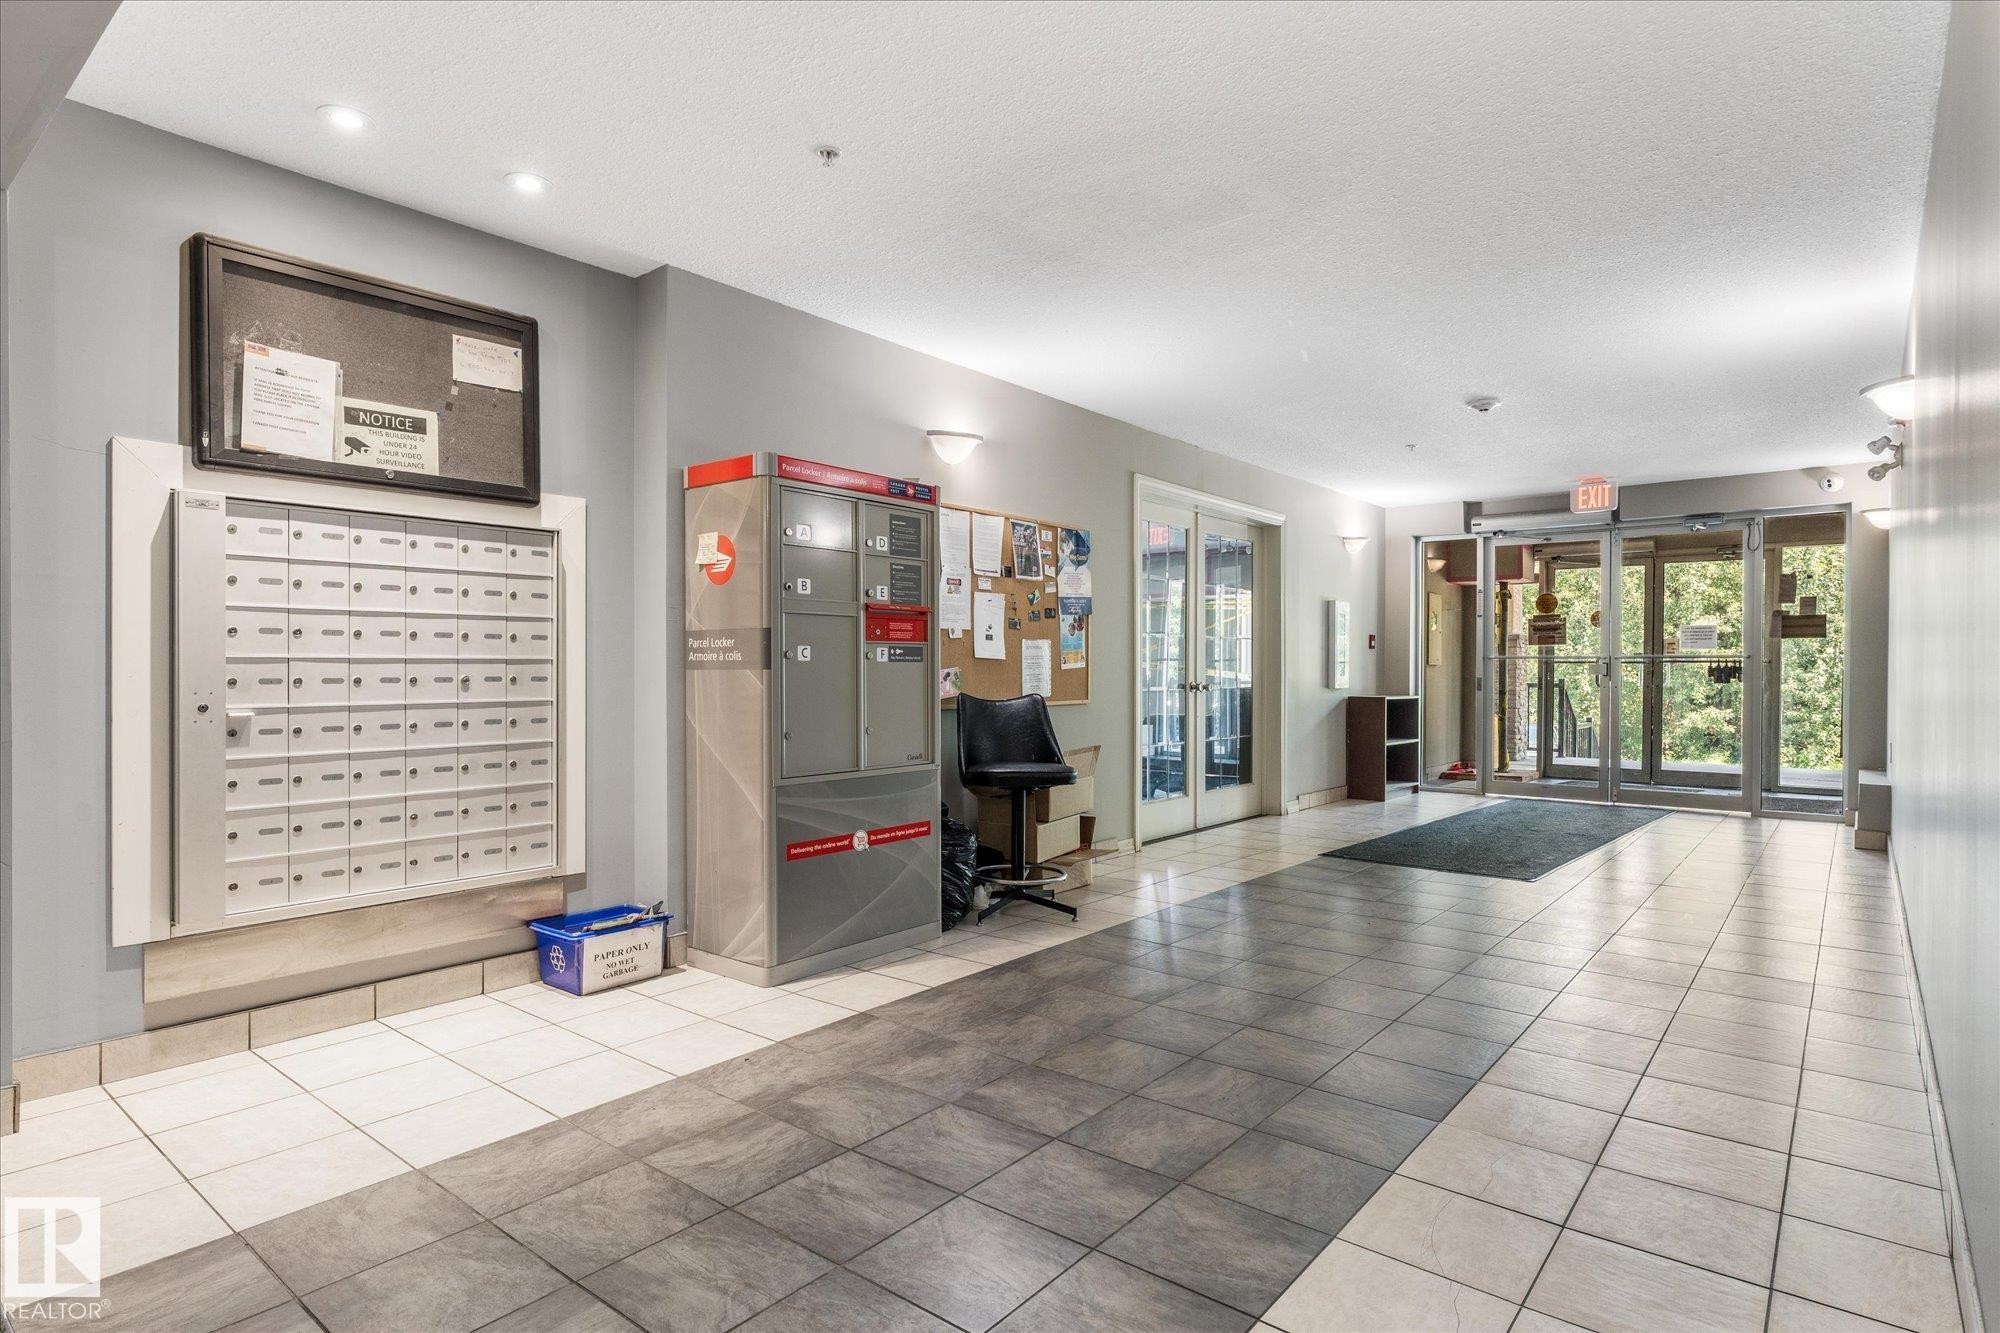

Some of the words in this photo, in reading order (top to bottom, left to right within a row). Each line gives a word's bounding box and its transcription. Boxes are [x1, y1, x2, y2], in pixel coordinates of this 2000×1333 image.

[359, 411, 413, 430] NOTICE
[368, 429, 384, 437] THIS
[385, 431, 418, 441] BUILDING
[383, 441, 407, 449] UNDER
[379, 449, 399, 458] HOUR
[401, 452, 423, 460] VIDEO
[376, 458, 425, 469] SURVEILLANCE
[783, 463, 800, 473] Parcel
[802, 467, 821, 477] Locker
[826, 472, 848, 482] Armoire
[855, 477, 867, 486] colis
[1579, 485, 1611, 508] EXIT
[800, 527, 807, 537] A
[879, 538, 885, 548] D
[802, 581, 807, 591] B
[880, 587, 885, 597] E
[688, 638, 709, 648] Parcel
[711, 637, 735, 648] Locker
[688, 651, 717, 661] Armoire
[725, 650, 742, 661] colis
[801, 648, 807, 658] C
[881, 649, 885, 659] F
[791, 845, 813, 855] Delivering
[823, 841, 836, 849] online
[593, 949, 625, 962] PAPER
[625, 941, 651, 954] ONLY
[606, 961, 617, 969] NO
[618, 957, 635, 967] WET
[602, 965, 639, 979] GARBAGE
